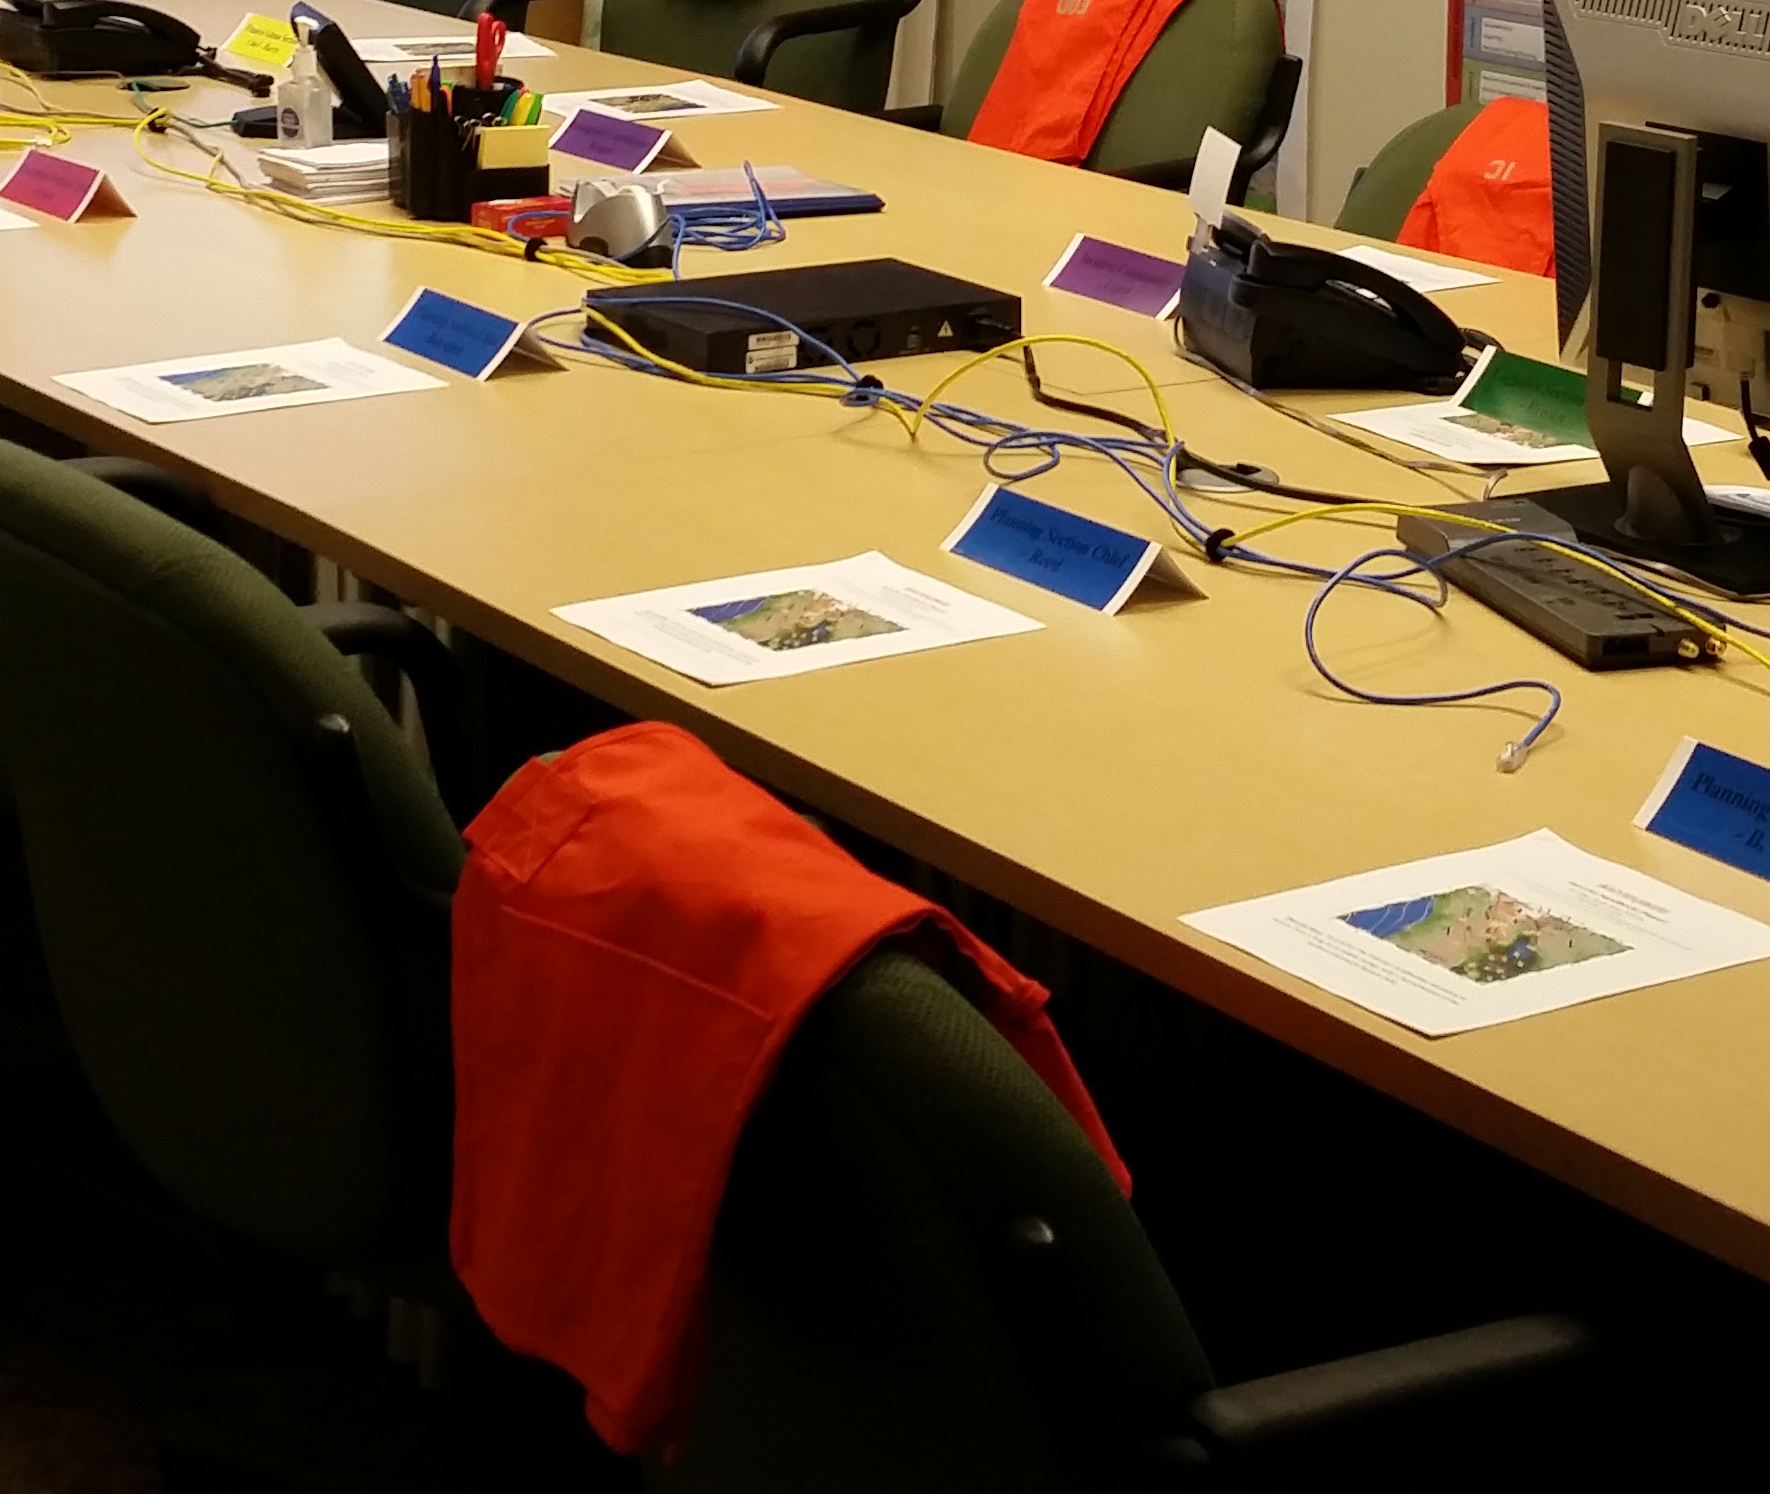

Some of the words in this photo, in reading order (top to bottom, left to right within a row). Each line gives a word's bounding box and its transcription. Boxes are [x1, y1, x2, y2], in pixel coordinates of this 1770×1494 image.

[1679, 3, 1764, 47] DELL
[1483, 159, 1517, 181] IC
[990, 507, 1045, 541] Planning
[1049, 527, 1090, 556] Section
[1091, 545, 1132, 569] Chief
[1690, 771, 1770, 823] Planning
[1745, 828, 1765, 853] B.
